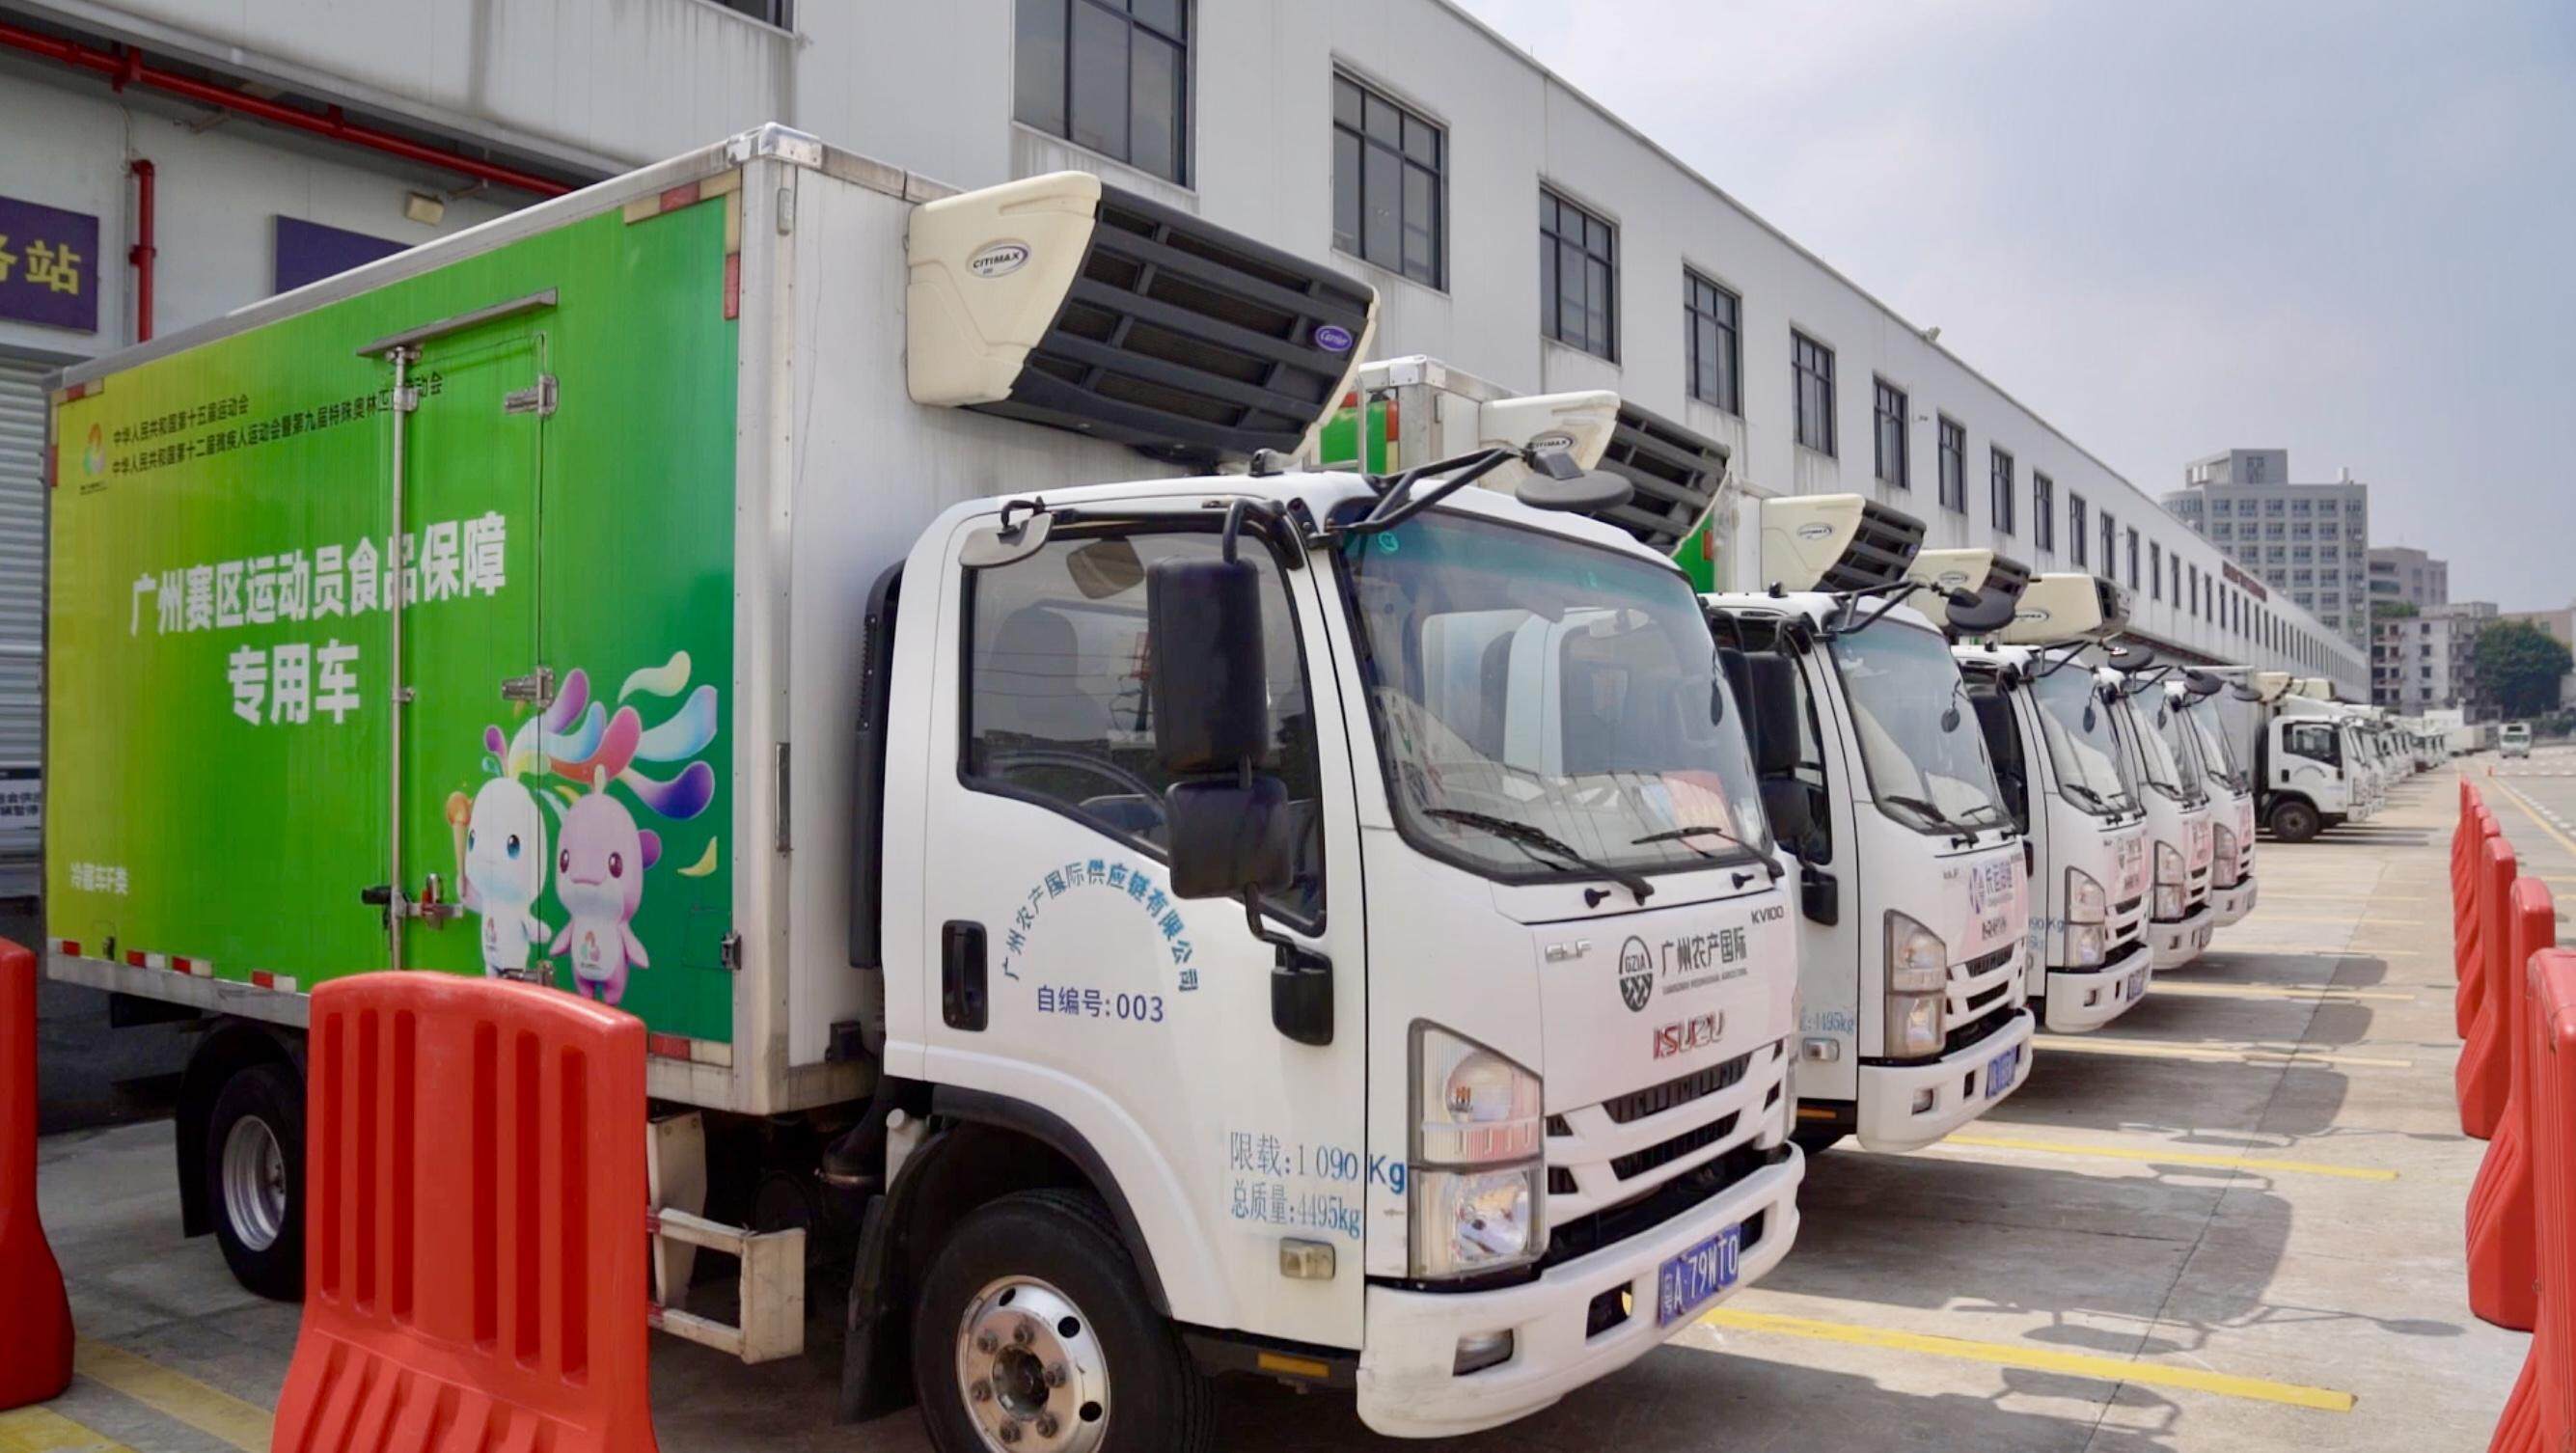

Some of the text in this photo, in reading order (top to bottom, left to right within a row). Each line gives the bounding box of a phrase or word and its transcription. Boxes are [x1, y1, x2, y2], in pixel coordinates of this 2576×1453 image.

[973, 251, 1020, 268] CITIMAX
[113, 394, 249, 449] 中华人民共和国第十五届运动会
[130, 510, 507, 638] 广州赛区运动员食品保障
[228, 638, 361, 726] 专用车
[1001, 858, 1199, 993] 广州农产国际供应链有限公司
[1545, 938, 1593, 964] ELF
[1660, 926, 1748, 977] 广州农产国际
[1037, 984, 1165, 1023] 自编号:003
[1653, 1009, 1725, 1060] ISUZU
